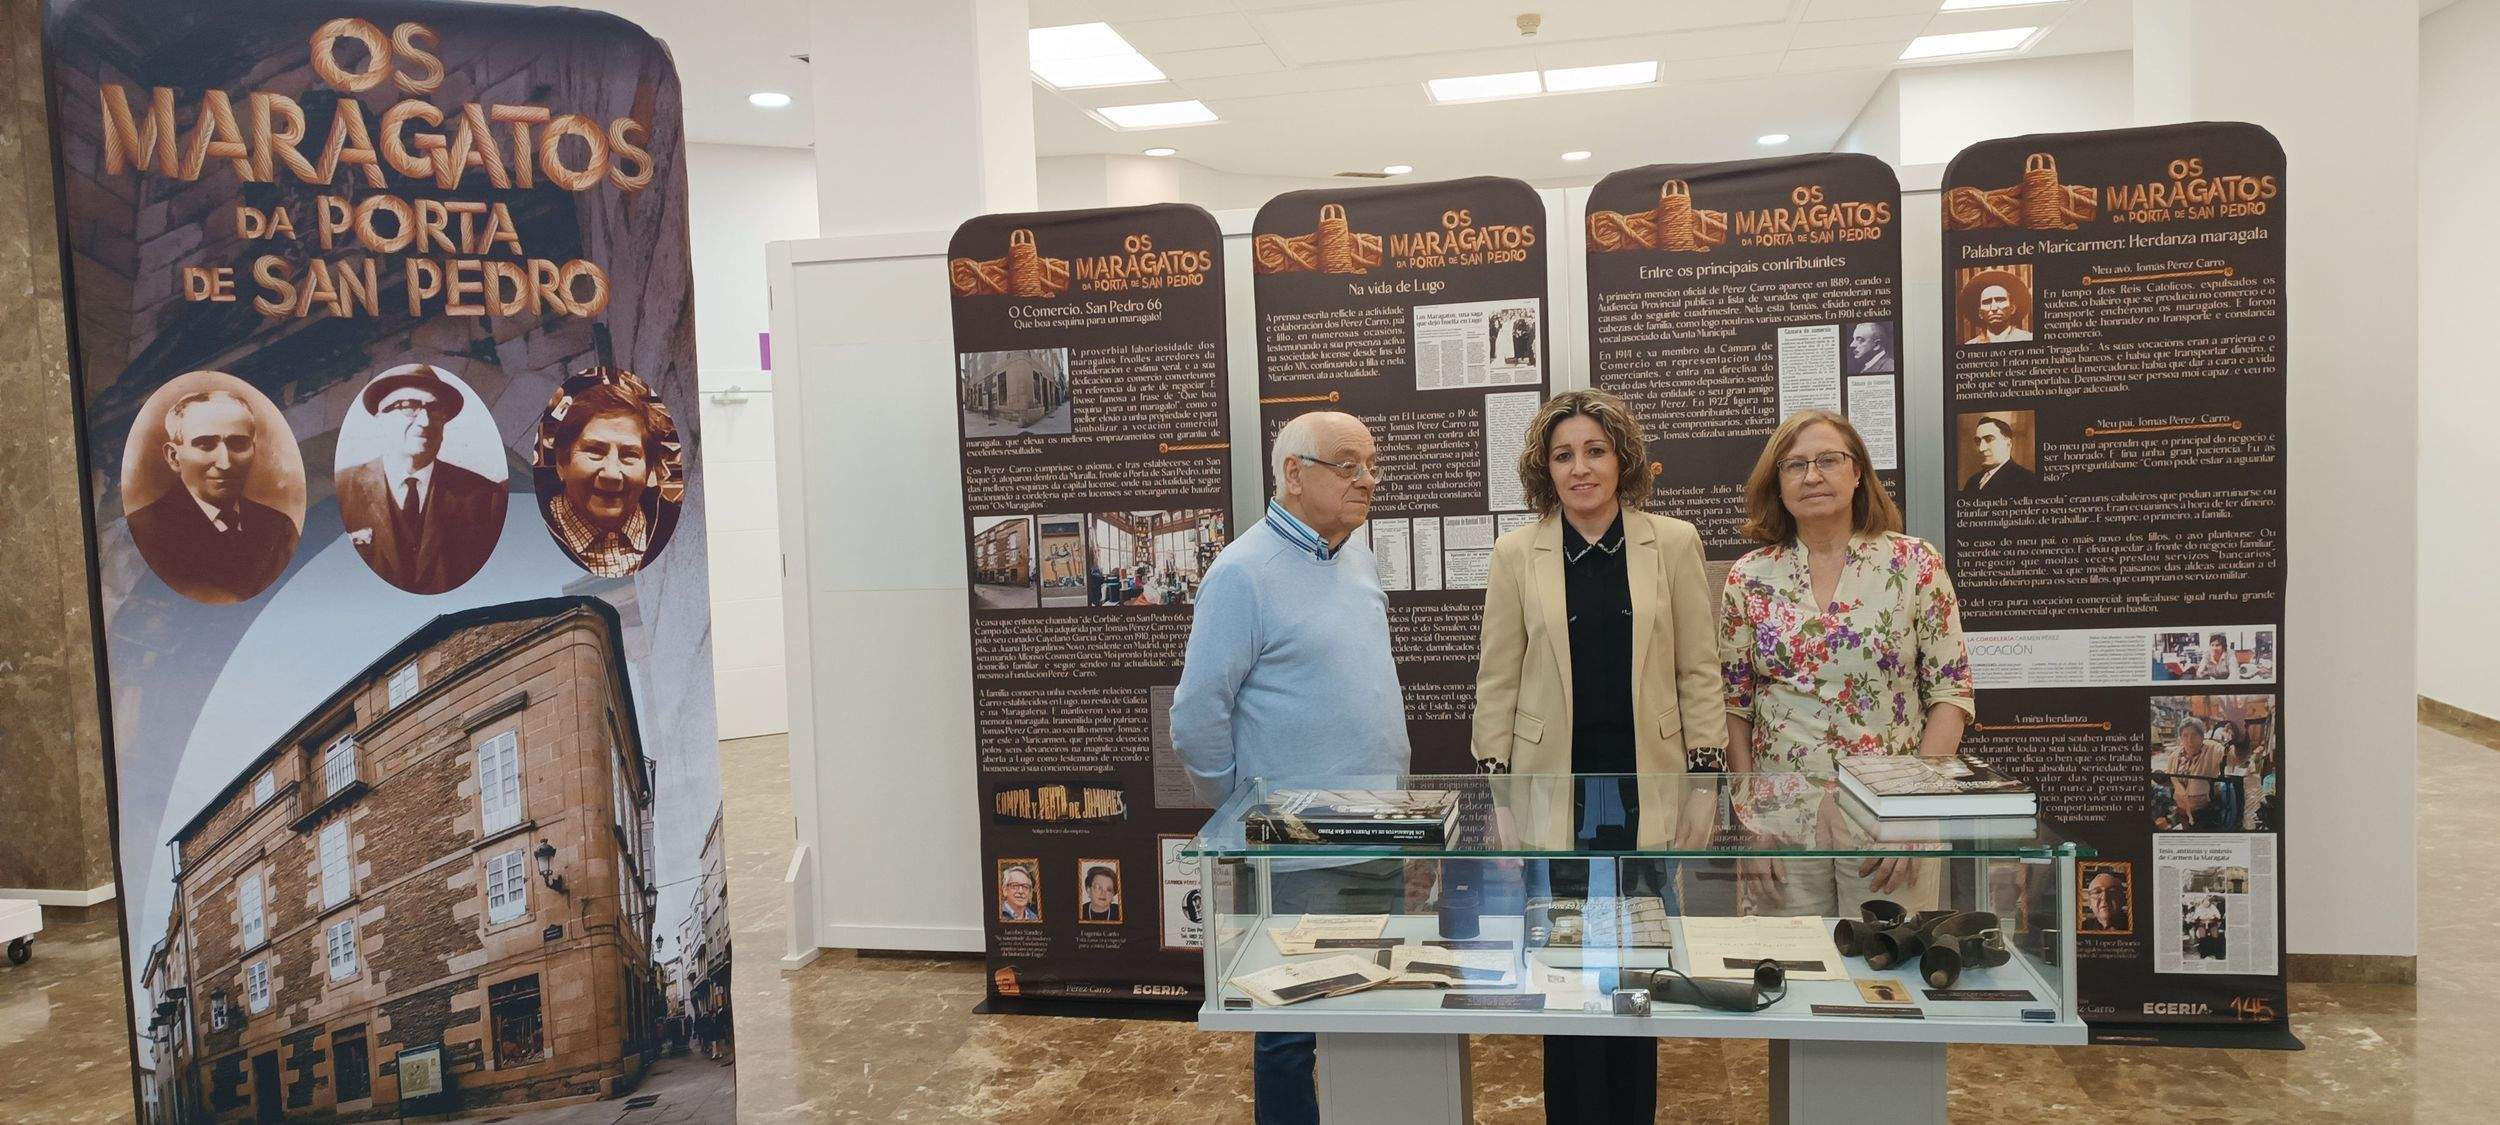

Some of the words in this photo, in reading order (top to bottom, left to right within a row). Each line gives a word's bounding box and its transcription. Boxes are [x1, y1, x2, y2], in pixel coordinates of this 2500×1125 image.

[311, 17, 445, 95] OS
[100, 85, 655, 191] MARAGATOS
[2169, 158, 2202, 179] OS
[1792, 185, 1823, 205] OS
[2106, 176, 2276, 209] MARAGATOS
[1442, 209, 1471, 228] OS
[1735, 202, 1890, 233] MARAGATOS
[2128, 208, 2170, 223] PORTA
[2188, 206, 2214, 219] SAN
[2220, 202, 2265, 216] PEDRO
[236, 205, 297, 240] DA
[317, 194, 524, 255] PORTA
[1124, 234, 1152, 252] OS
[1390, 225, 1535, 256] MARAGATOS
[1755, 233, 1794, 246] PORTA
[1810, 230, 1833, 243] SAN
[1839, 227, 1880, 241] PEDRO
[1962, 244, 2012, 258] Palabra
[2017, 242, 2034, 255] de
[2038, 239, 2125, 253] Maricarmen:
[2129, 233, 2196, 247] Herdanza
[1076, 250, 1211, 278] MARAGATOS
[1409, 255, 1445, 268] PORTA
[1460, 252, 1482, 265] SAN
[1487, 250, 1526, 263] PEDRO
[2195, 258, 2225, 267] Carro
[1639, 266, 1673, 279] Entre
[1677, 267, 1693, 276] os
[1696, 260, 1758, 278] principais
[184, 266, 236, 302] DE
[252, 255, 379, 318] SAN
[407, 258, 611, 318] PEDRO
[1094, 279, 1128, 290] PORTA
[1141, 276, 1162, 288] SAN
[1166, 274, 1203, 286] PEDRO
[1349, 283, 1364, 295] Na
[1367, 281, 1392, 294] vida
[1395, 280, 1410, 292] de
[1414, 279, 1444, 294] Lugo
[2096, 286, 2115, 295] dos
[2120, 284, 2141, 293] Reis
[1606, 291, 1641, 303] primeira
[1708, 285, 1720, 294] de
[1749, 283, 1775, 292] Carro
[1778, 282, 1813, 292] aparece
[1008, 305, 1020, 318] O
[1086, 302, 1107, 314] San
[1109, 299, 1144, 312] Pedro
[1146, 298, 1162, 310] 66
[1014, 319, 1032, 329] Que
[1034, 318, 1050, 327] boa
[1086, 317, 1105, 327] para
[1198, 341, 1214, 349] dos
[1394, 346, 1405, 354] do
[1599, 359, 1650, 370] Comercio
[1754, 352, 1773, 361] dos
[2200, 414, 2230, 423] Carro
